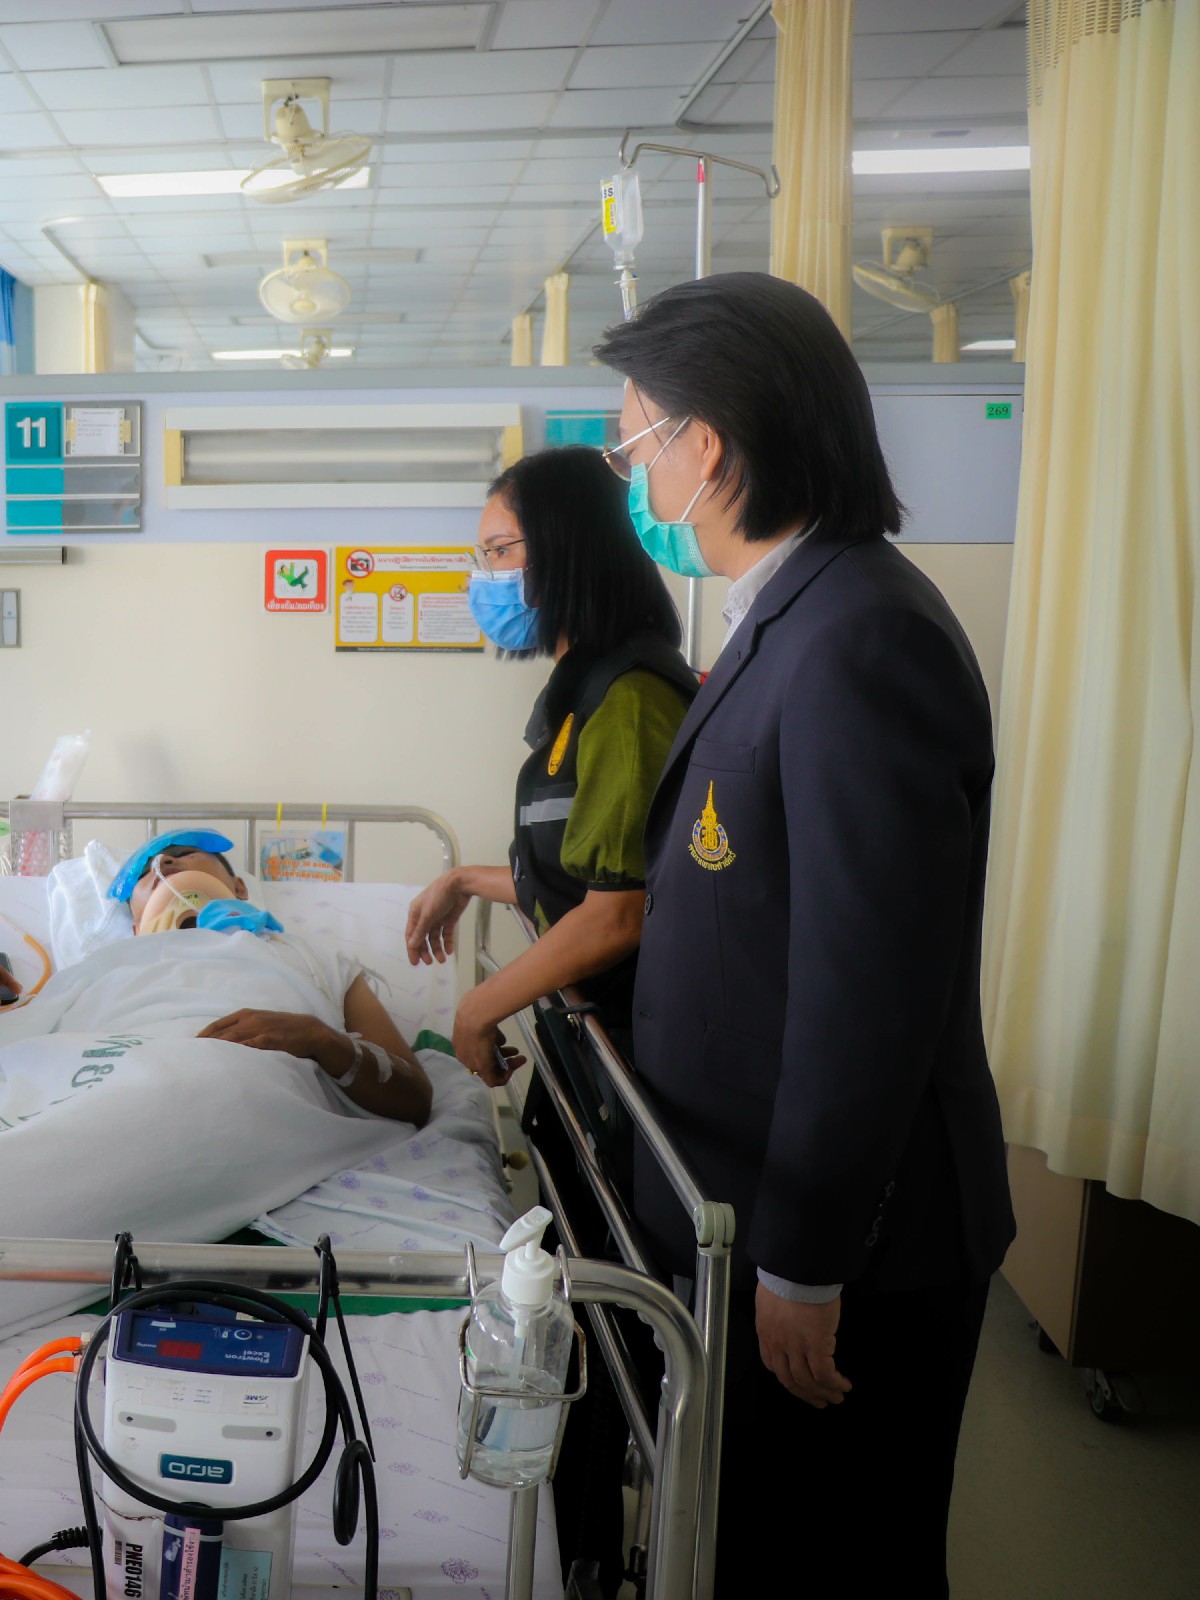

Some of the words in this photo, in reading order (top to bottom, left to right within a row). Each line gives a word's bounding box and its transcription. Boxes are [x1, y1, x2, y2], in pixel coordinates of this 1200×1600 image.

[988, 406, 1009, 416] 269
[16, 416, 47, 449] 11
[224, 1353, 270, 1364] Flowtron
[242, 1350, 271, 1358] Excel
